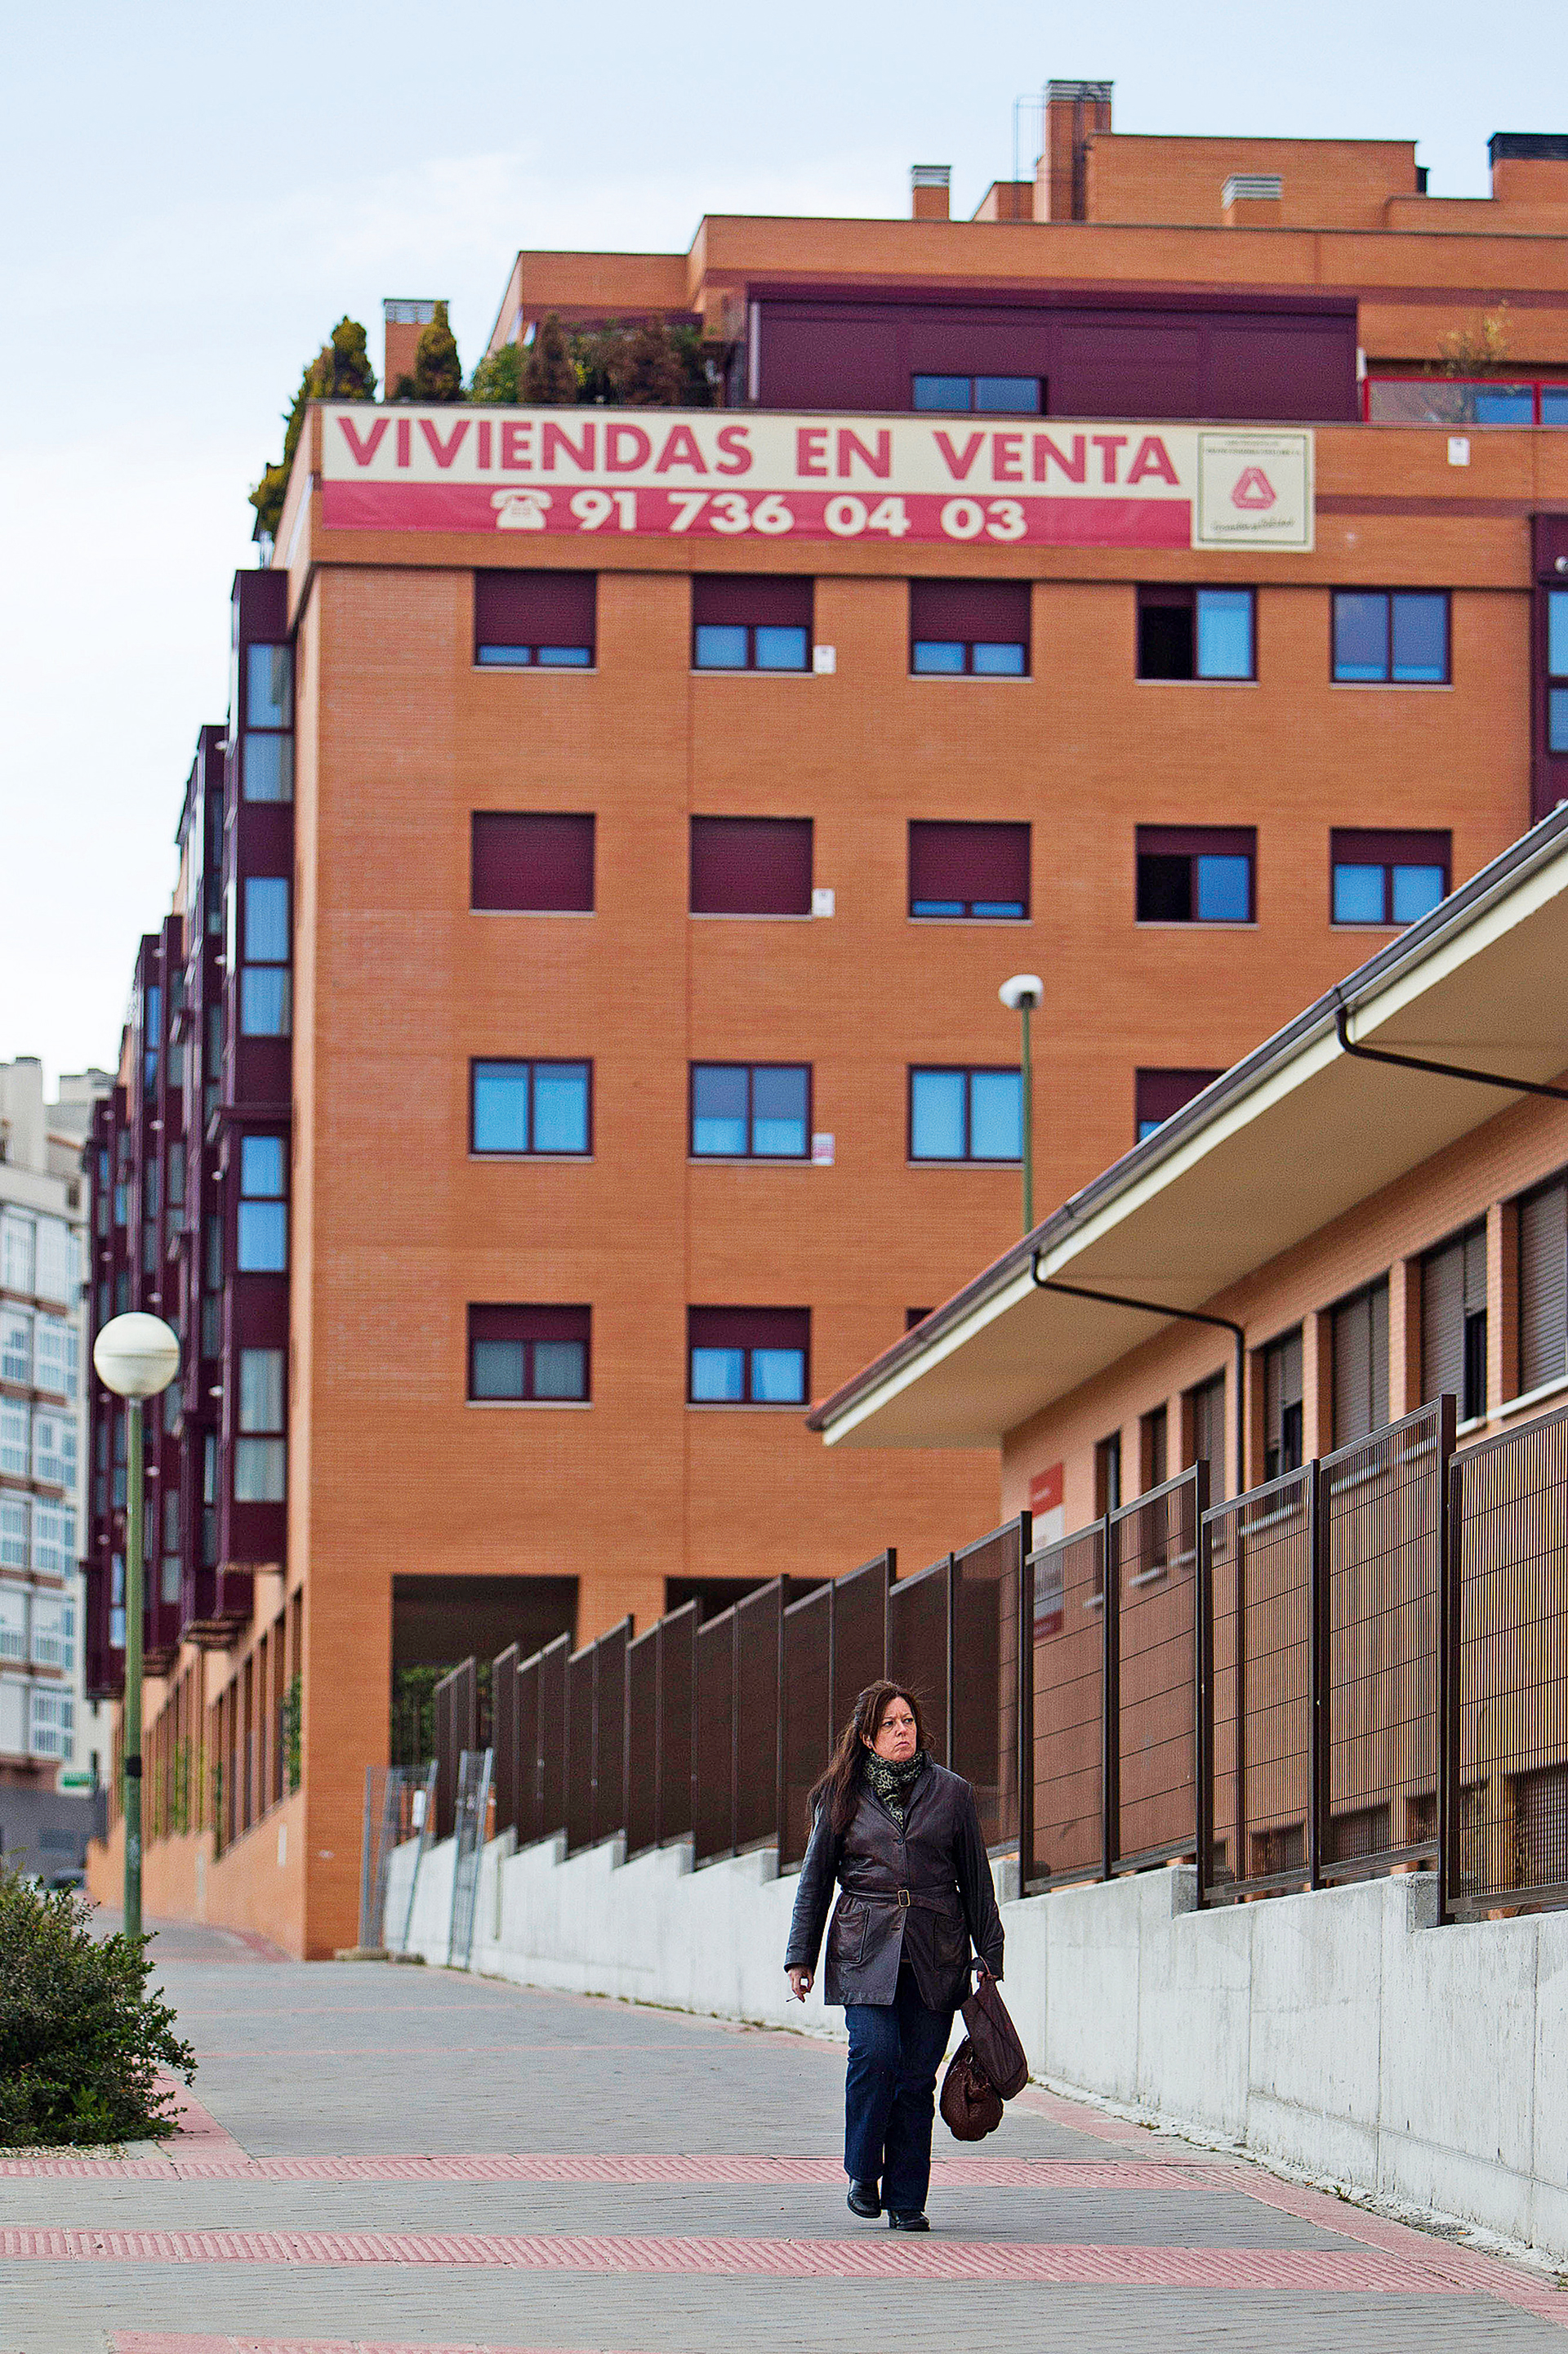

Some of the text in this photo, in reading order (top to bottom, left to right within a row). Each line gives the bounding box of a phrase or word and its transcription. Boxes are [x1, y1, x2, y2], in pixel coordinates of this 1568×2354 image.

[337, 417, 1179, 485] VIVIENDAS EN VENTA
[571, 490, 1028, 541] 91 736 04 03
